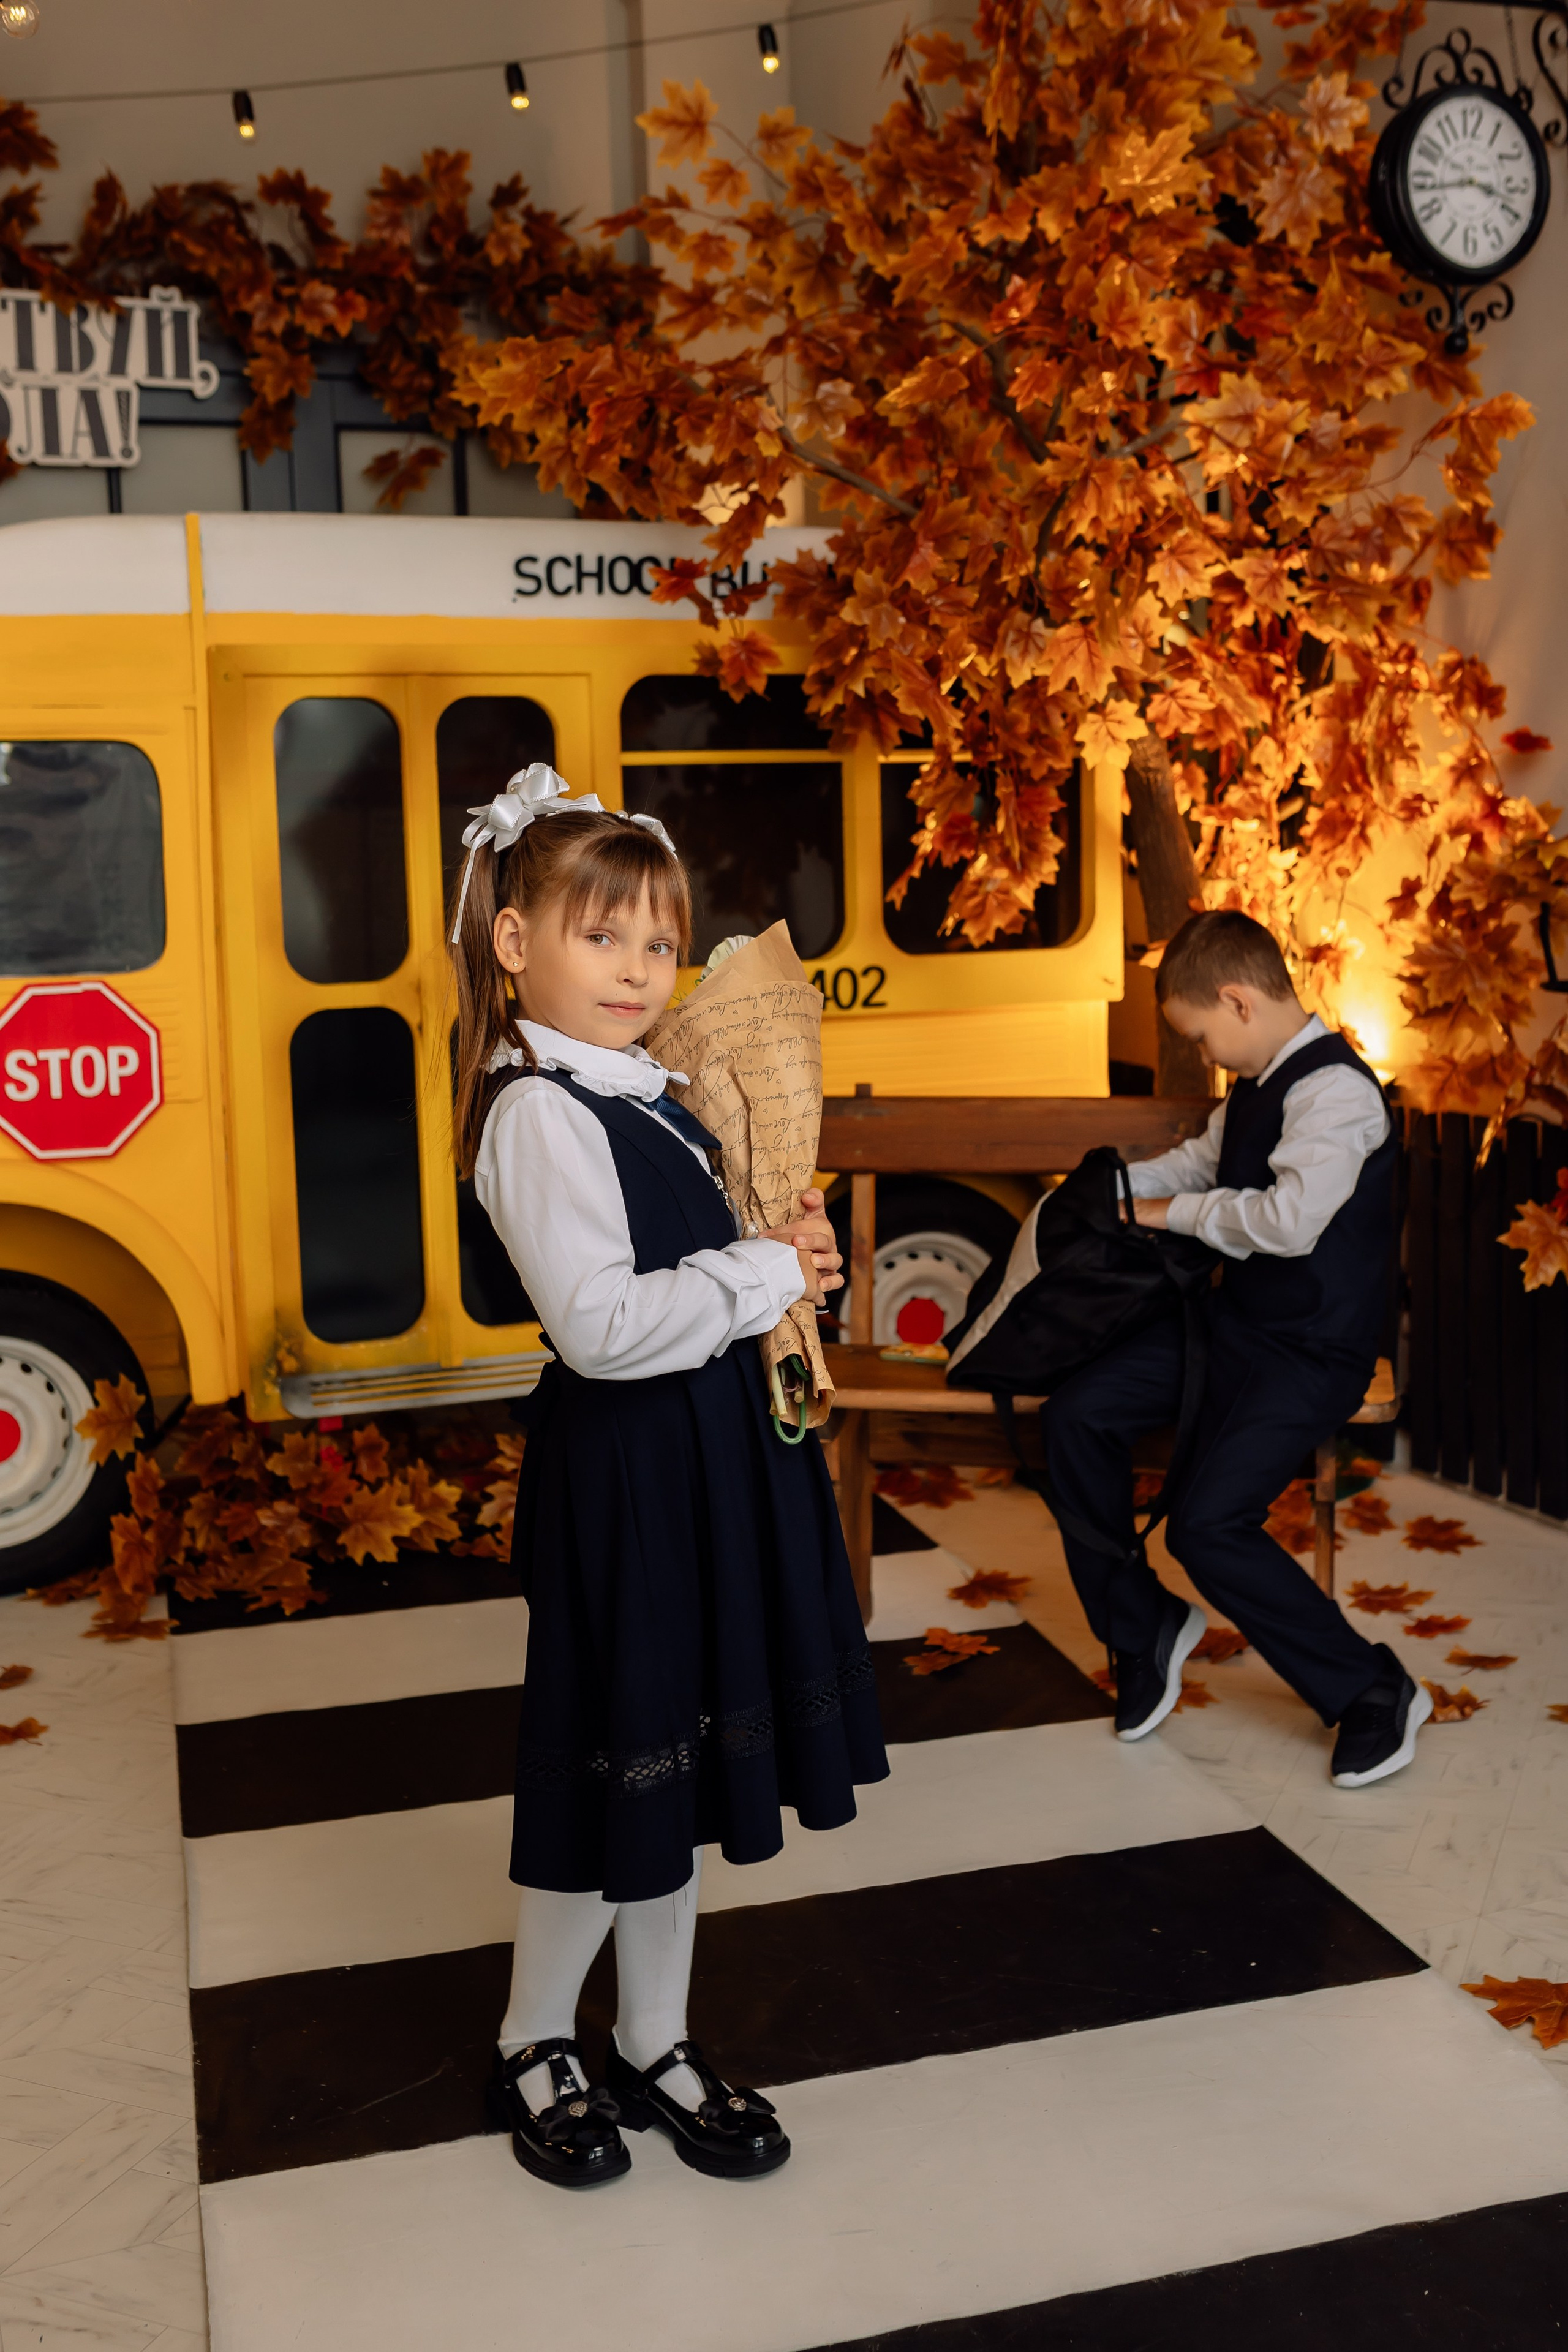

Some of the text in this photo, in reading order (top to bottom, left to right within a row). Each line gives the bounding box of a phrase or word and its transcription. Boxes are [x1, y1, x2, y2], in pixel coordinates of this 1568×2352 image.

[1438, 113, 1459, 146] 11
[1462, 105, 1483, 140] 12
[1488, 122, 1502, 147] 1
[1505, 175, 1530, 195] 3
[1419, 197, 1443, 223] 8
[1439, 217, 1458, 246] 7
[1463, 225, 1478, 258] 6
[1482, 217, 1504, 250] 5
[0, 388, 134, 458] ЛА!
[514, 554, 677, 597] SCHOO
[707, 1001, 730, 1016] Love
[747, 1017, 767, 1032] Love
[726, 1047, 745, 1060] Love
[4, 1044, 140, 1102] STOP
[758, 1067, 780, 1082] Love
[774, 1118, 796, 1133] Love
[791, 1163, 815, 1176] Love
[777, 1337, 797, 1351] Love
